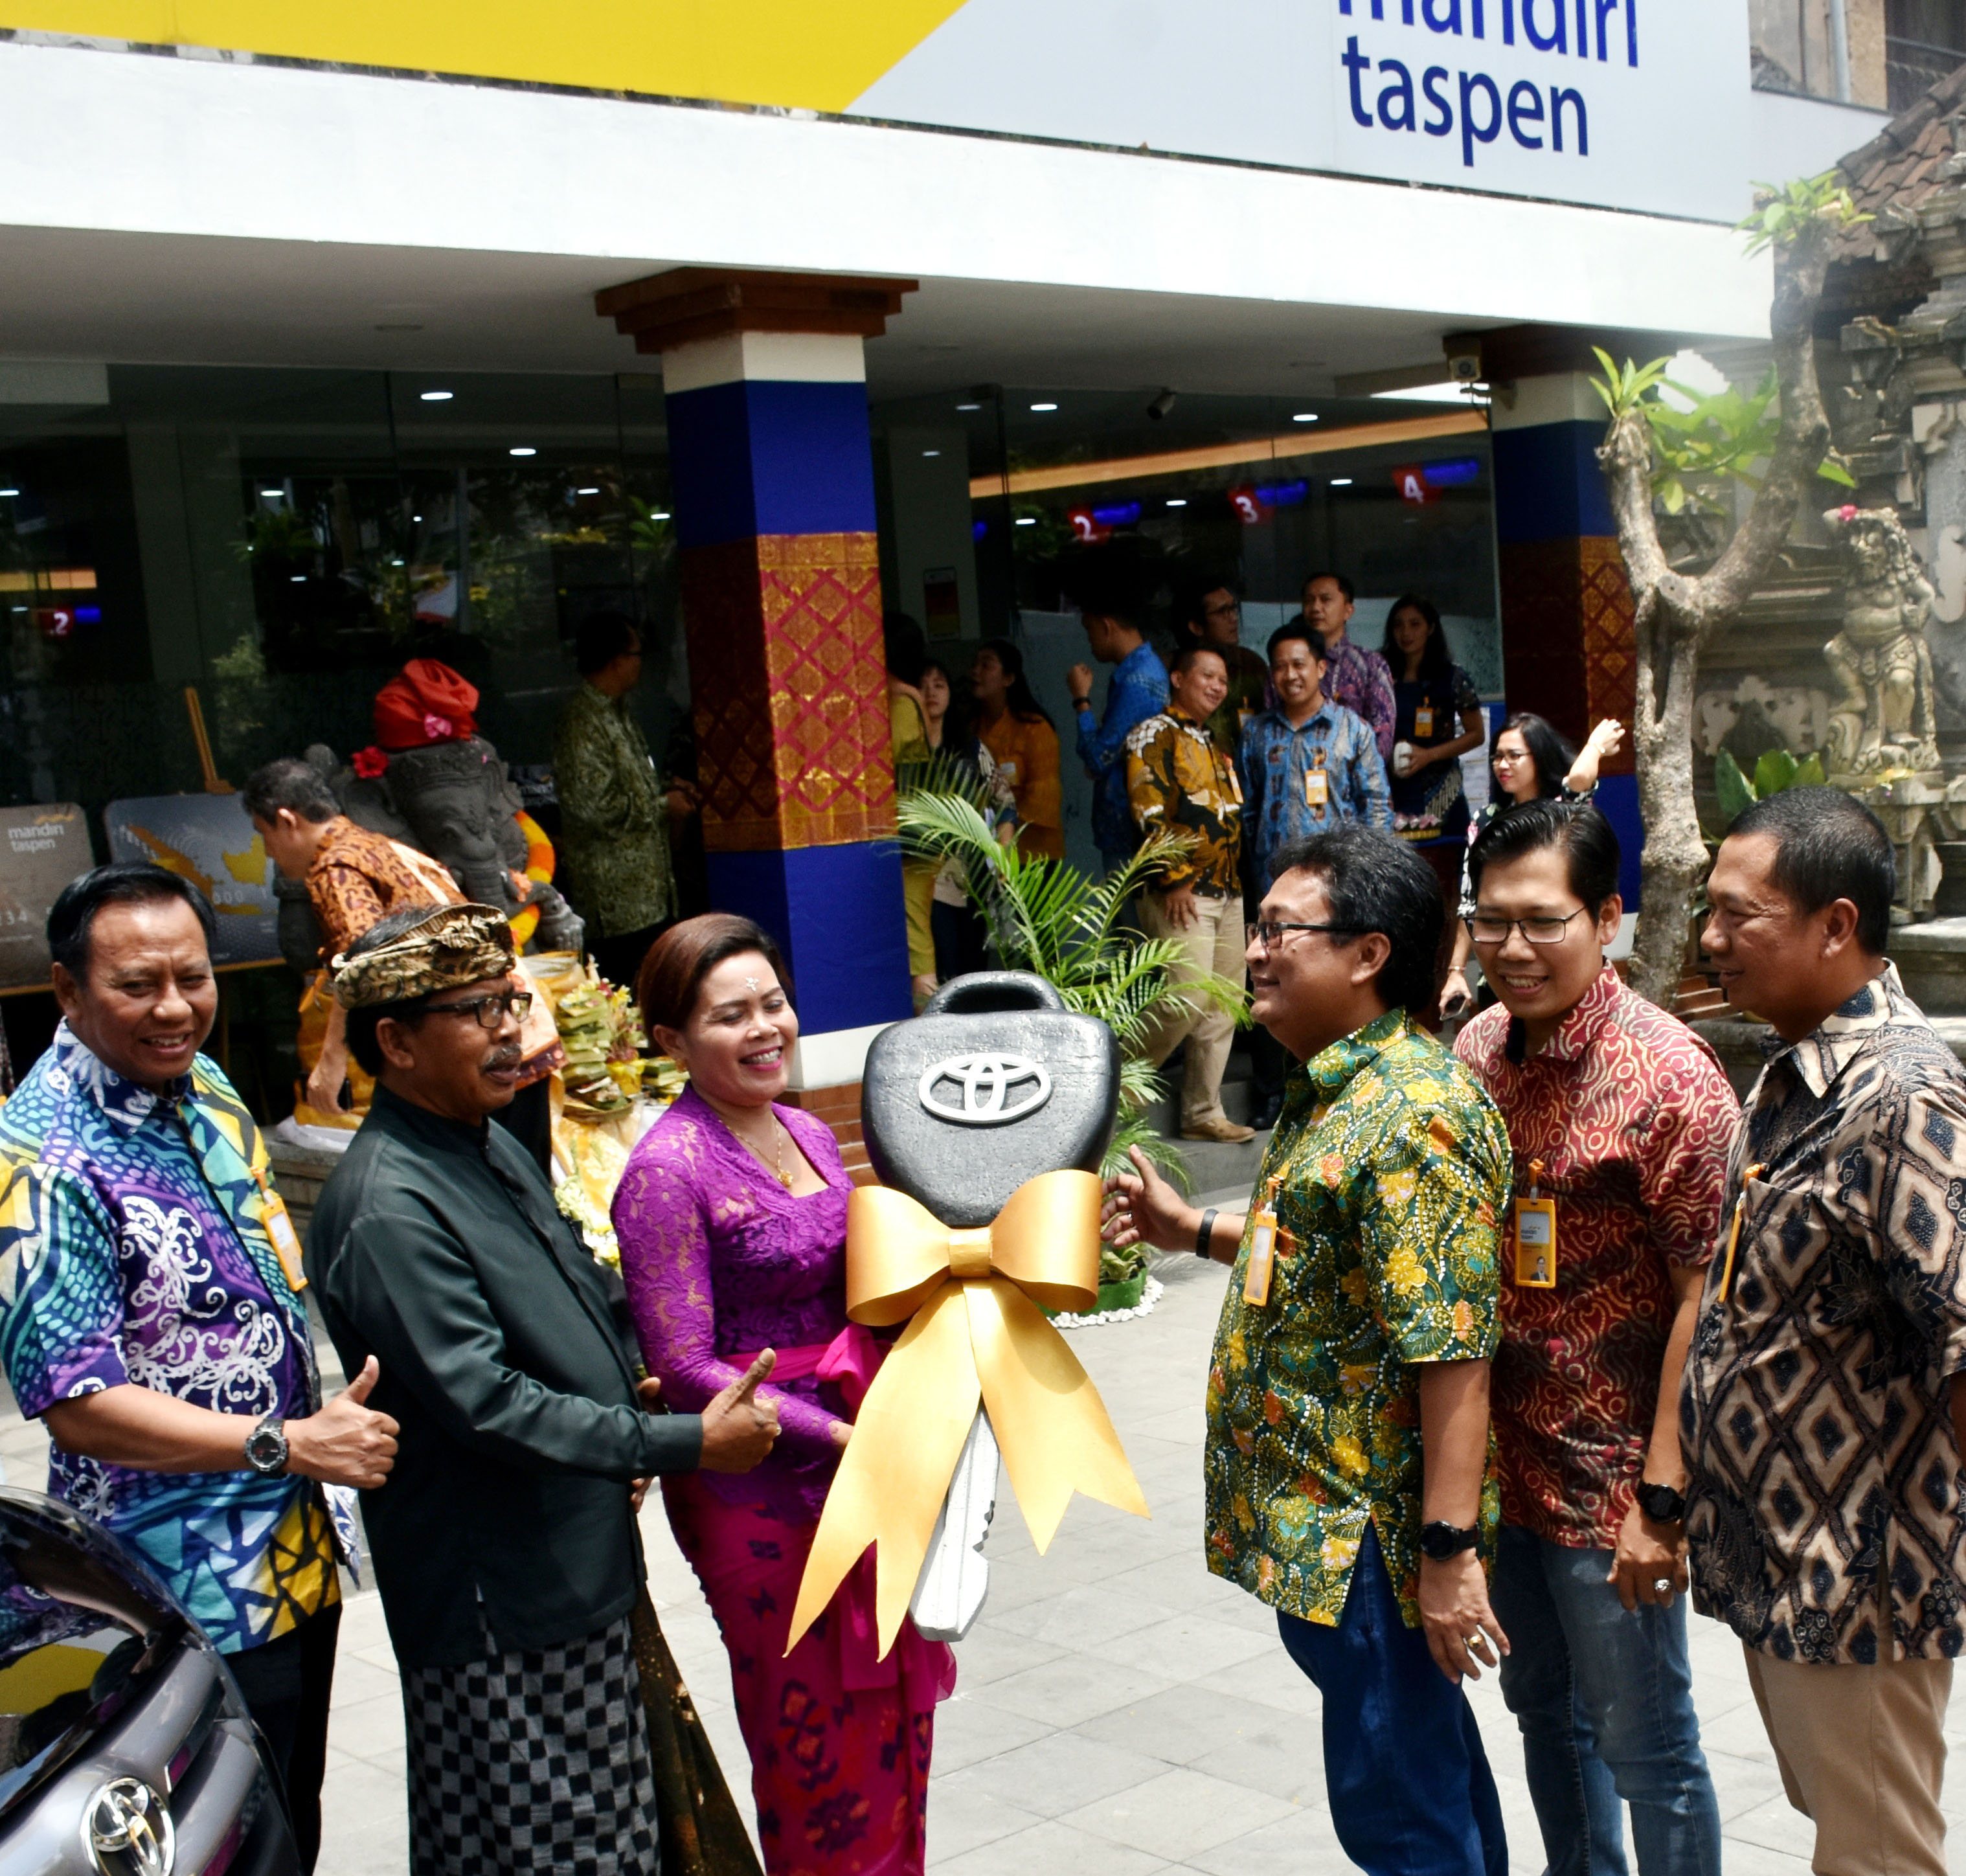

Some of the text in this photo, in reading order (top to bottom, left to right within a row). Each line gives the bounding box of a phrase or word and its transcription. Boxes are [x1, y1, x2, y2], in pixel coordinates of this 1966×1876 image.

[1339, 0, 1638, 67] andiri
[1341, 36, 1588, 166] taspen
[1404, 475, 1423, 502] 4
[1235, 495, 1258, 522] 3
[1074, 515, 1096, 540] 2
